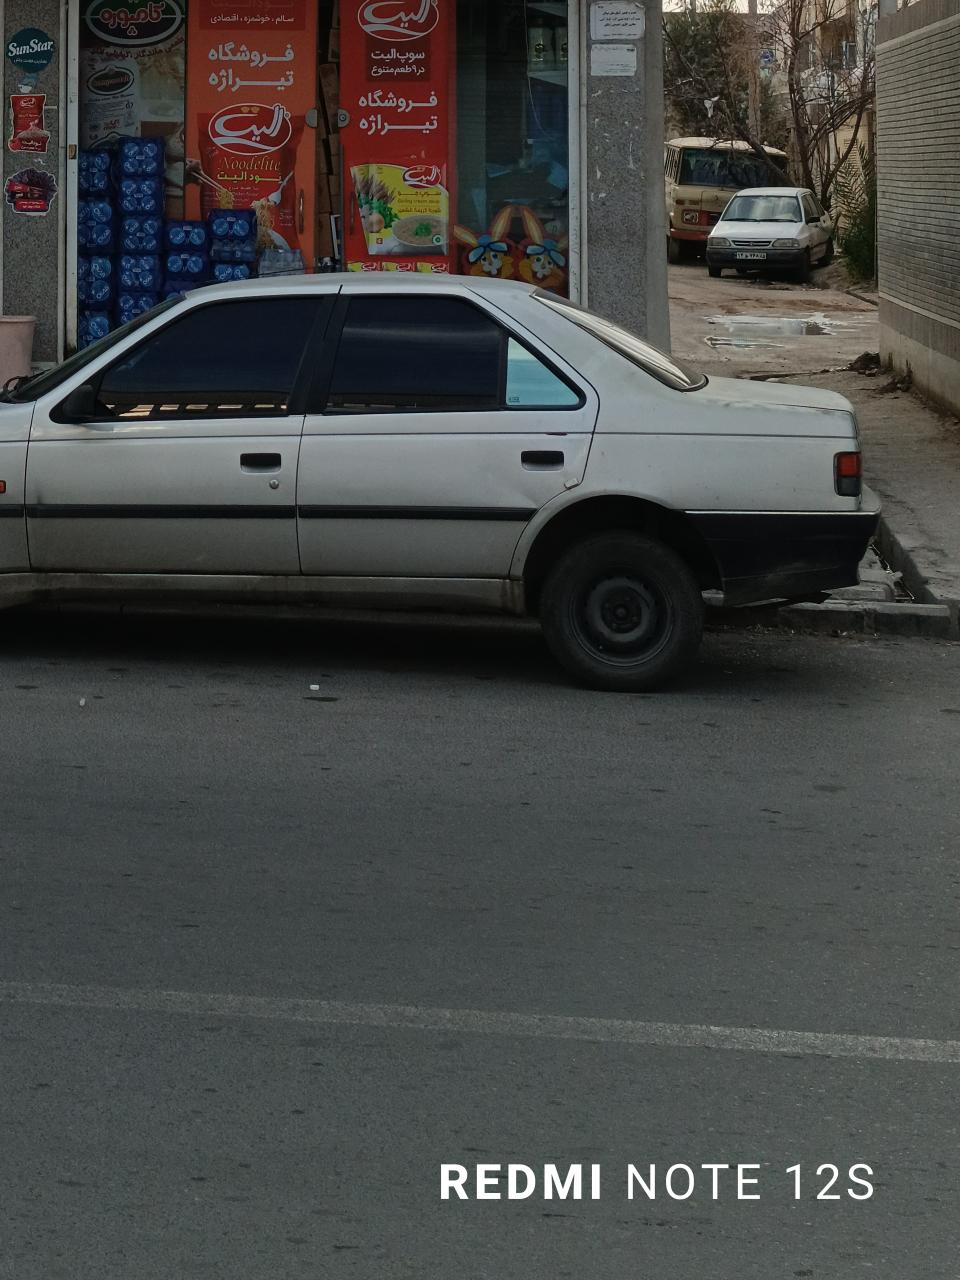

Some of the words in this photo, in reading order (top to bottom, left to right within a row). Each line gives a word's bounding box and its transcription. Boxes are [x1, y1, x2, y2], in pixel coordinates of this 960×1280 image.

[210, 13, 239, 24] اقتصادی
[8, 38, 54, 57] SunStar
[208, 41, 295, 68] فروشگاه
[371, 48, 397, 62] الیت
[396, 48, 425, 63] سوپ
[208, 68, 294, 92] تیراژه
[371, 65, 395, 77] متنوع
[394, 65, 413, 76] طعم
[358, 89, 438, 112] فروشگاه
[214, 104, 286, 141] الیت
[359, 113, 438, 135] تیراژه
